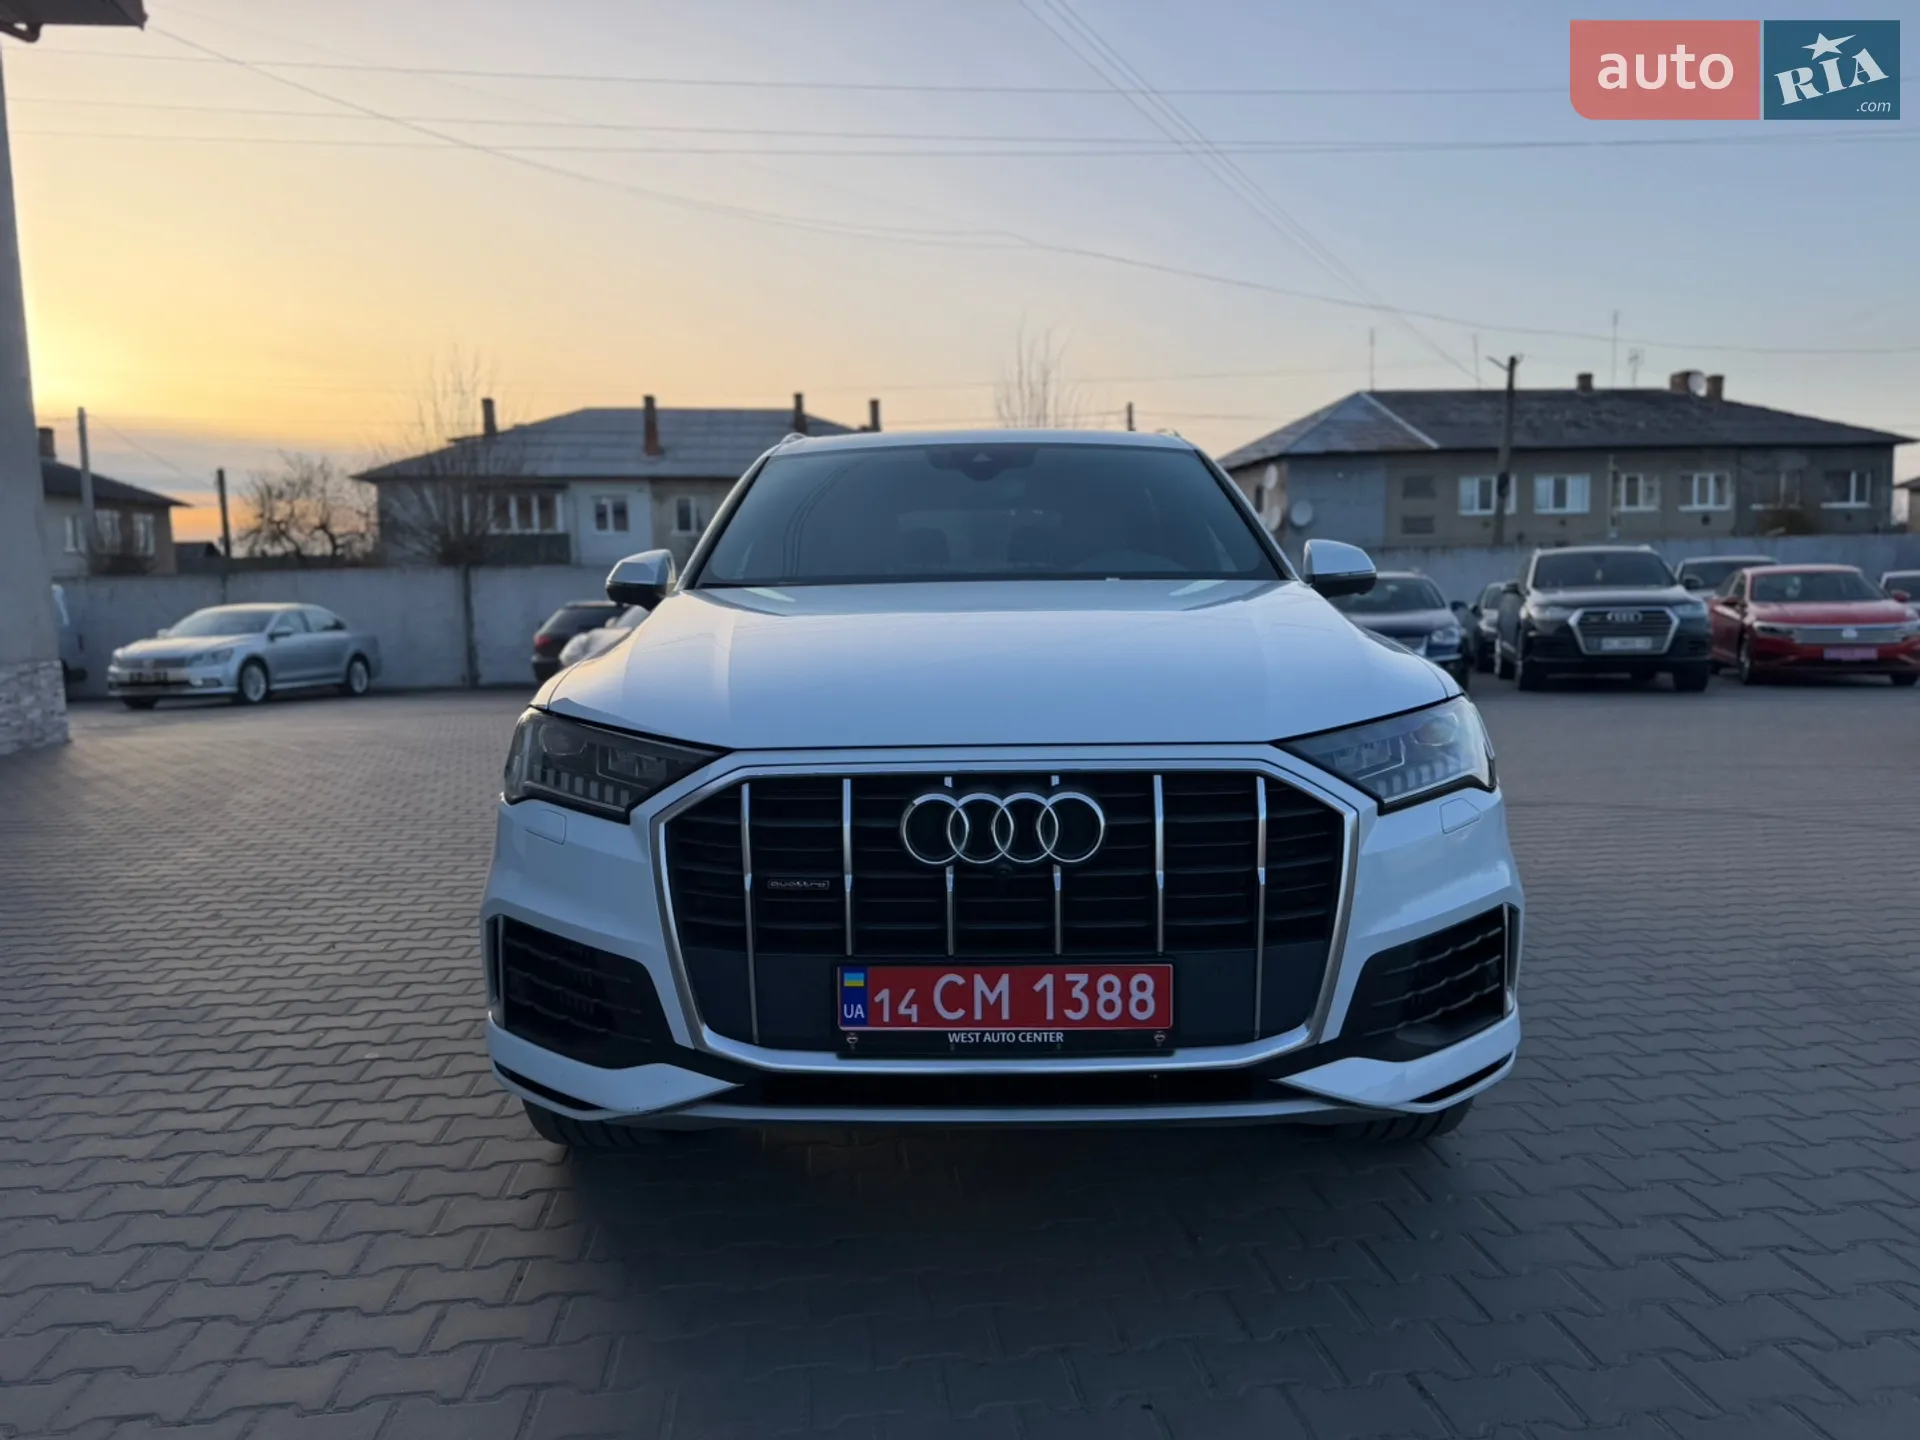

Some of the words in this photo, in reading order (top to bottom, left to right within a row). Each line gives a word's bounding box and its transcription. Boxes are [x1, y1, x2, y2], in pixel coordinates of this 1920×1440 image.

[873, 988, 918, 1023] 14
[933, 973, 1010, 1021] CM
[1032, 973, 1156, 1021] 1388
[843, 1003, 865, 1019] UA
[948, 1032, 981, 1043] WEST
[983, 1032, 1016, 1043] AUTO
[1018, 1032, 1064, 1043] CENTER
